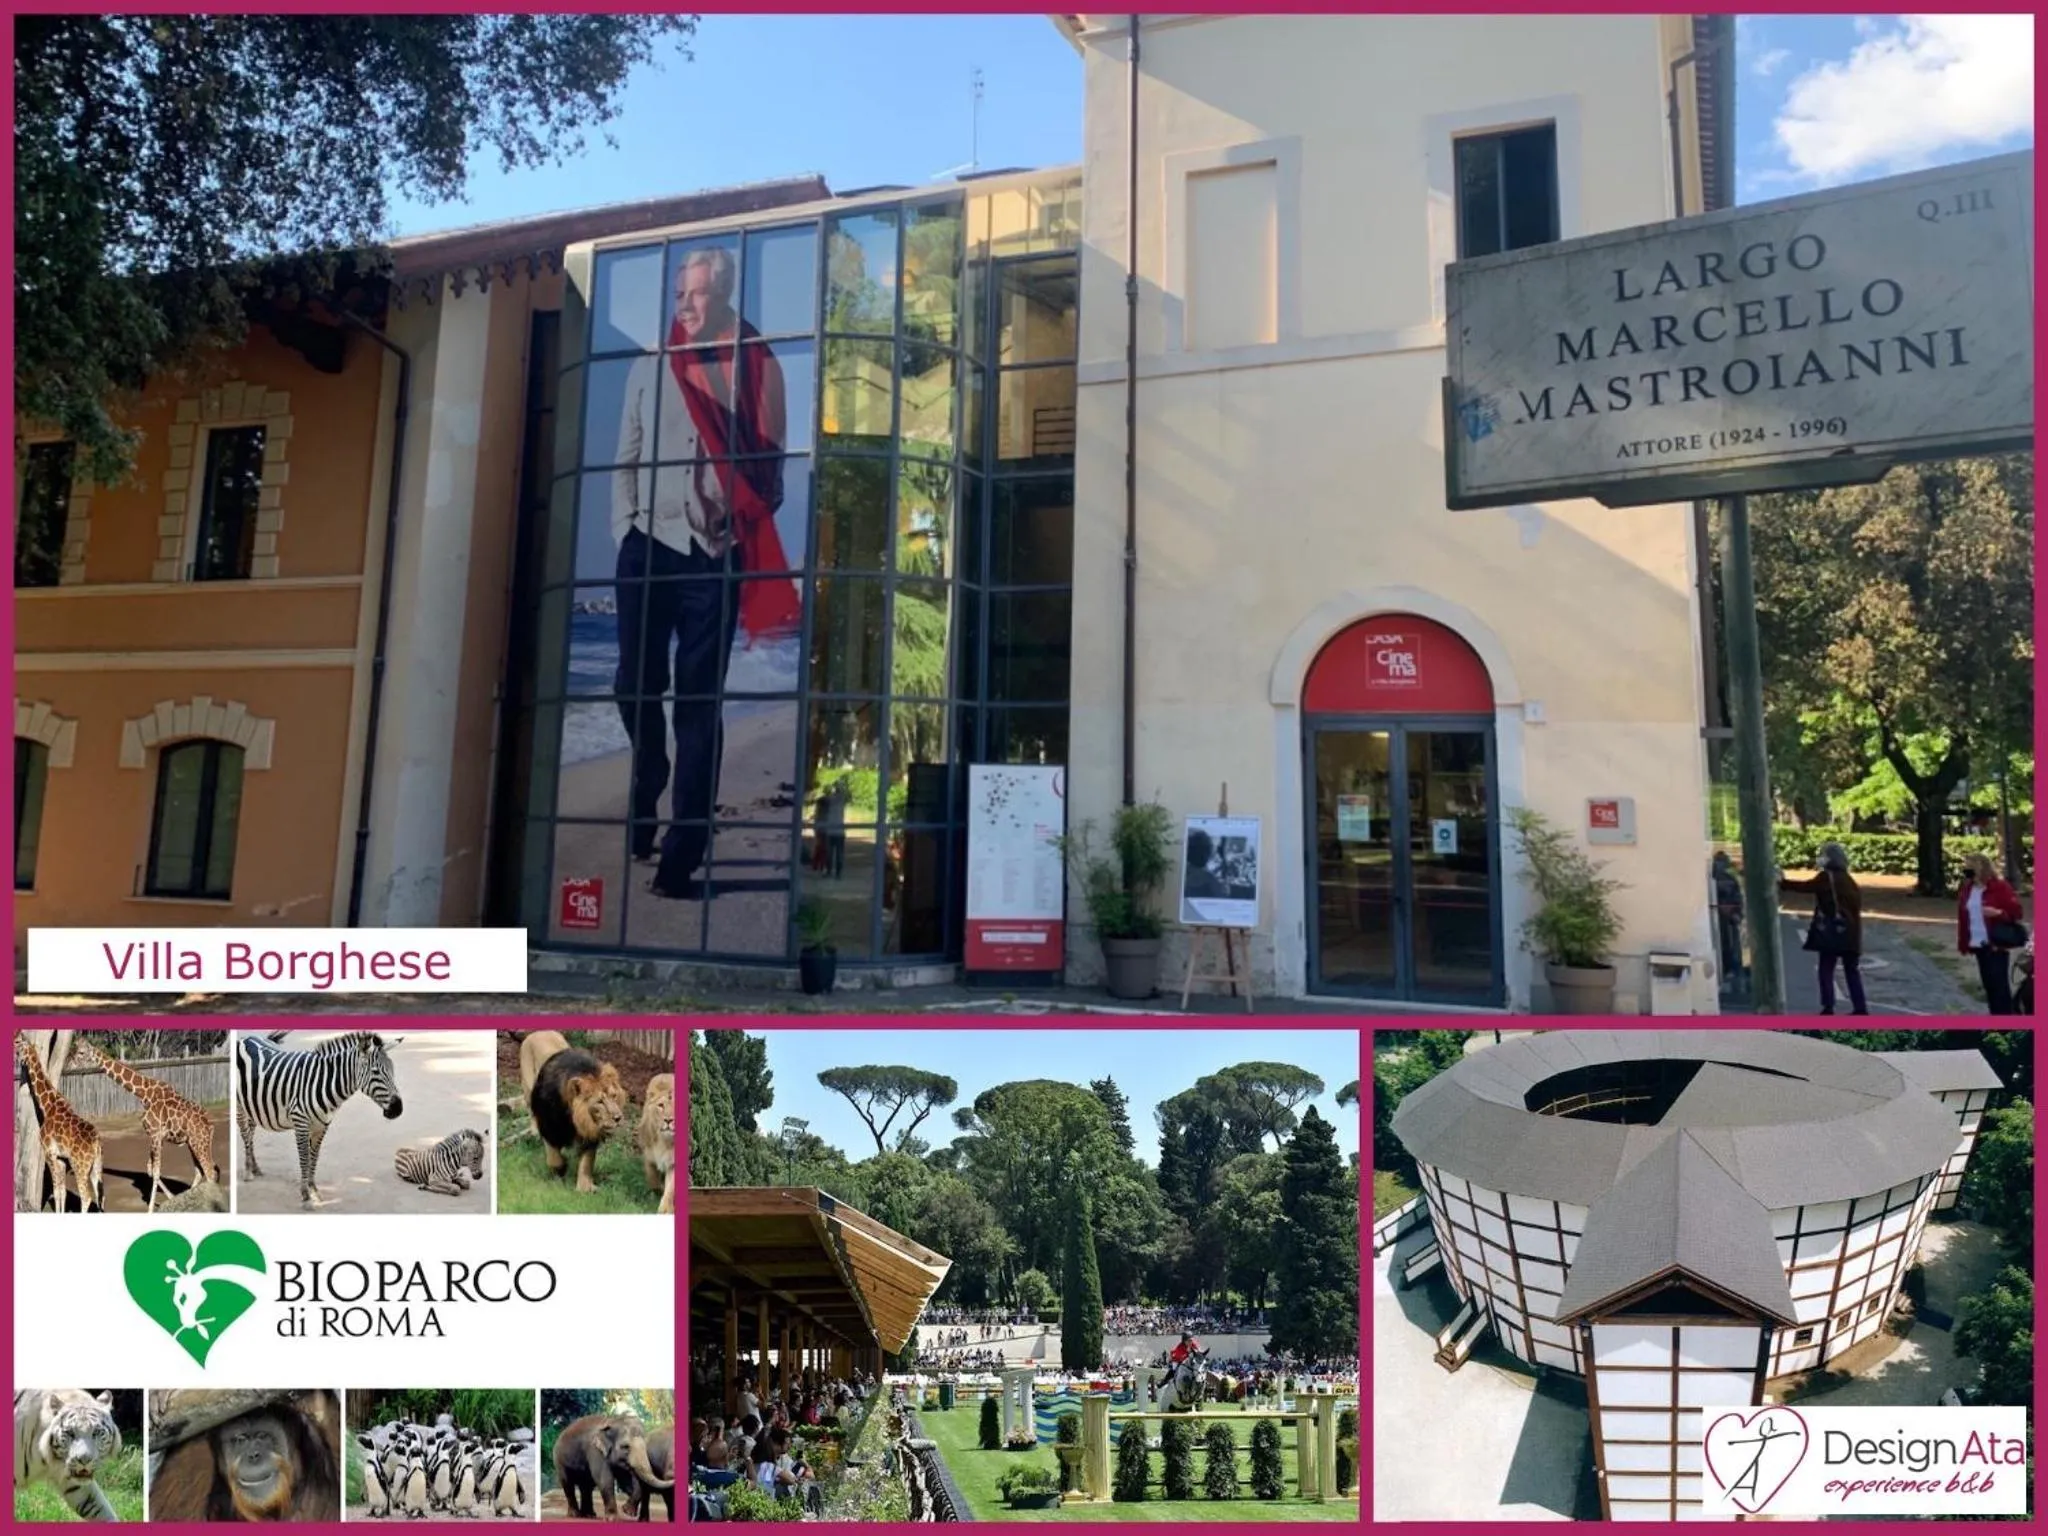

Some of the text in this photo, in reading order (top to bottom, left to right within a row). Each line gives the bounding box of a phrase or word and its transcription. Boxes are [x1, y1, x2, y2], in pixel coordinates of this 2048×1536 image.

[1917, 189, 1995, 223] Q.III
[1613, 234, 1826, 303] LARGO
[1555, 278, 1904, 366] MARCELLO
[1512, 327, 1971, 425] MASTROIANNI
[1616, 433, 1702, 459] ATTORE
[1709, 427, 1766, 452] (1924
[1788, 416, 1848, 440] 1996)
[1376, 648, 1414, 666] Cine
[1389, 664, 1417, 676] ma
[569, 891, 597, 907] Cine
[577, 906, 598, 919] ma
